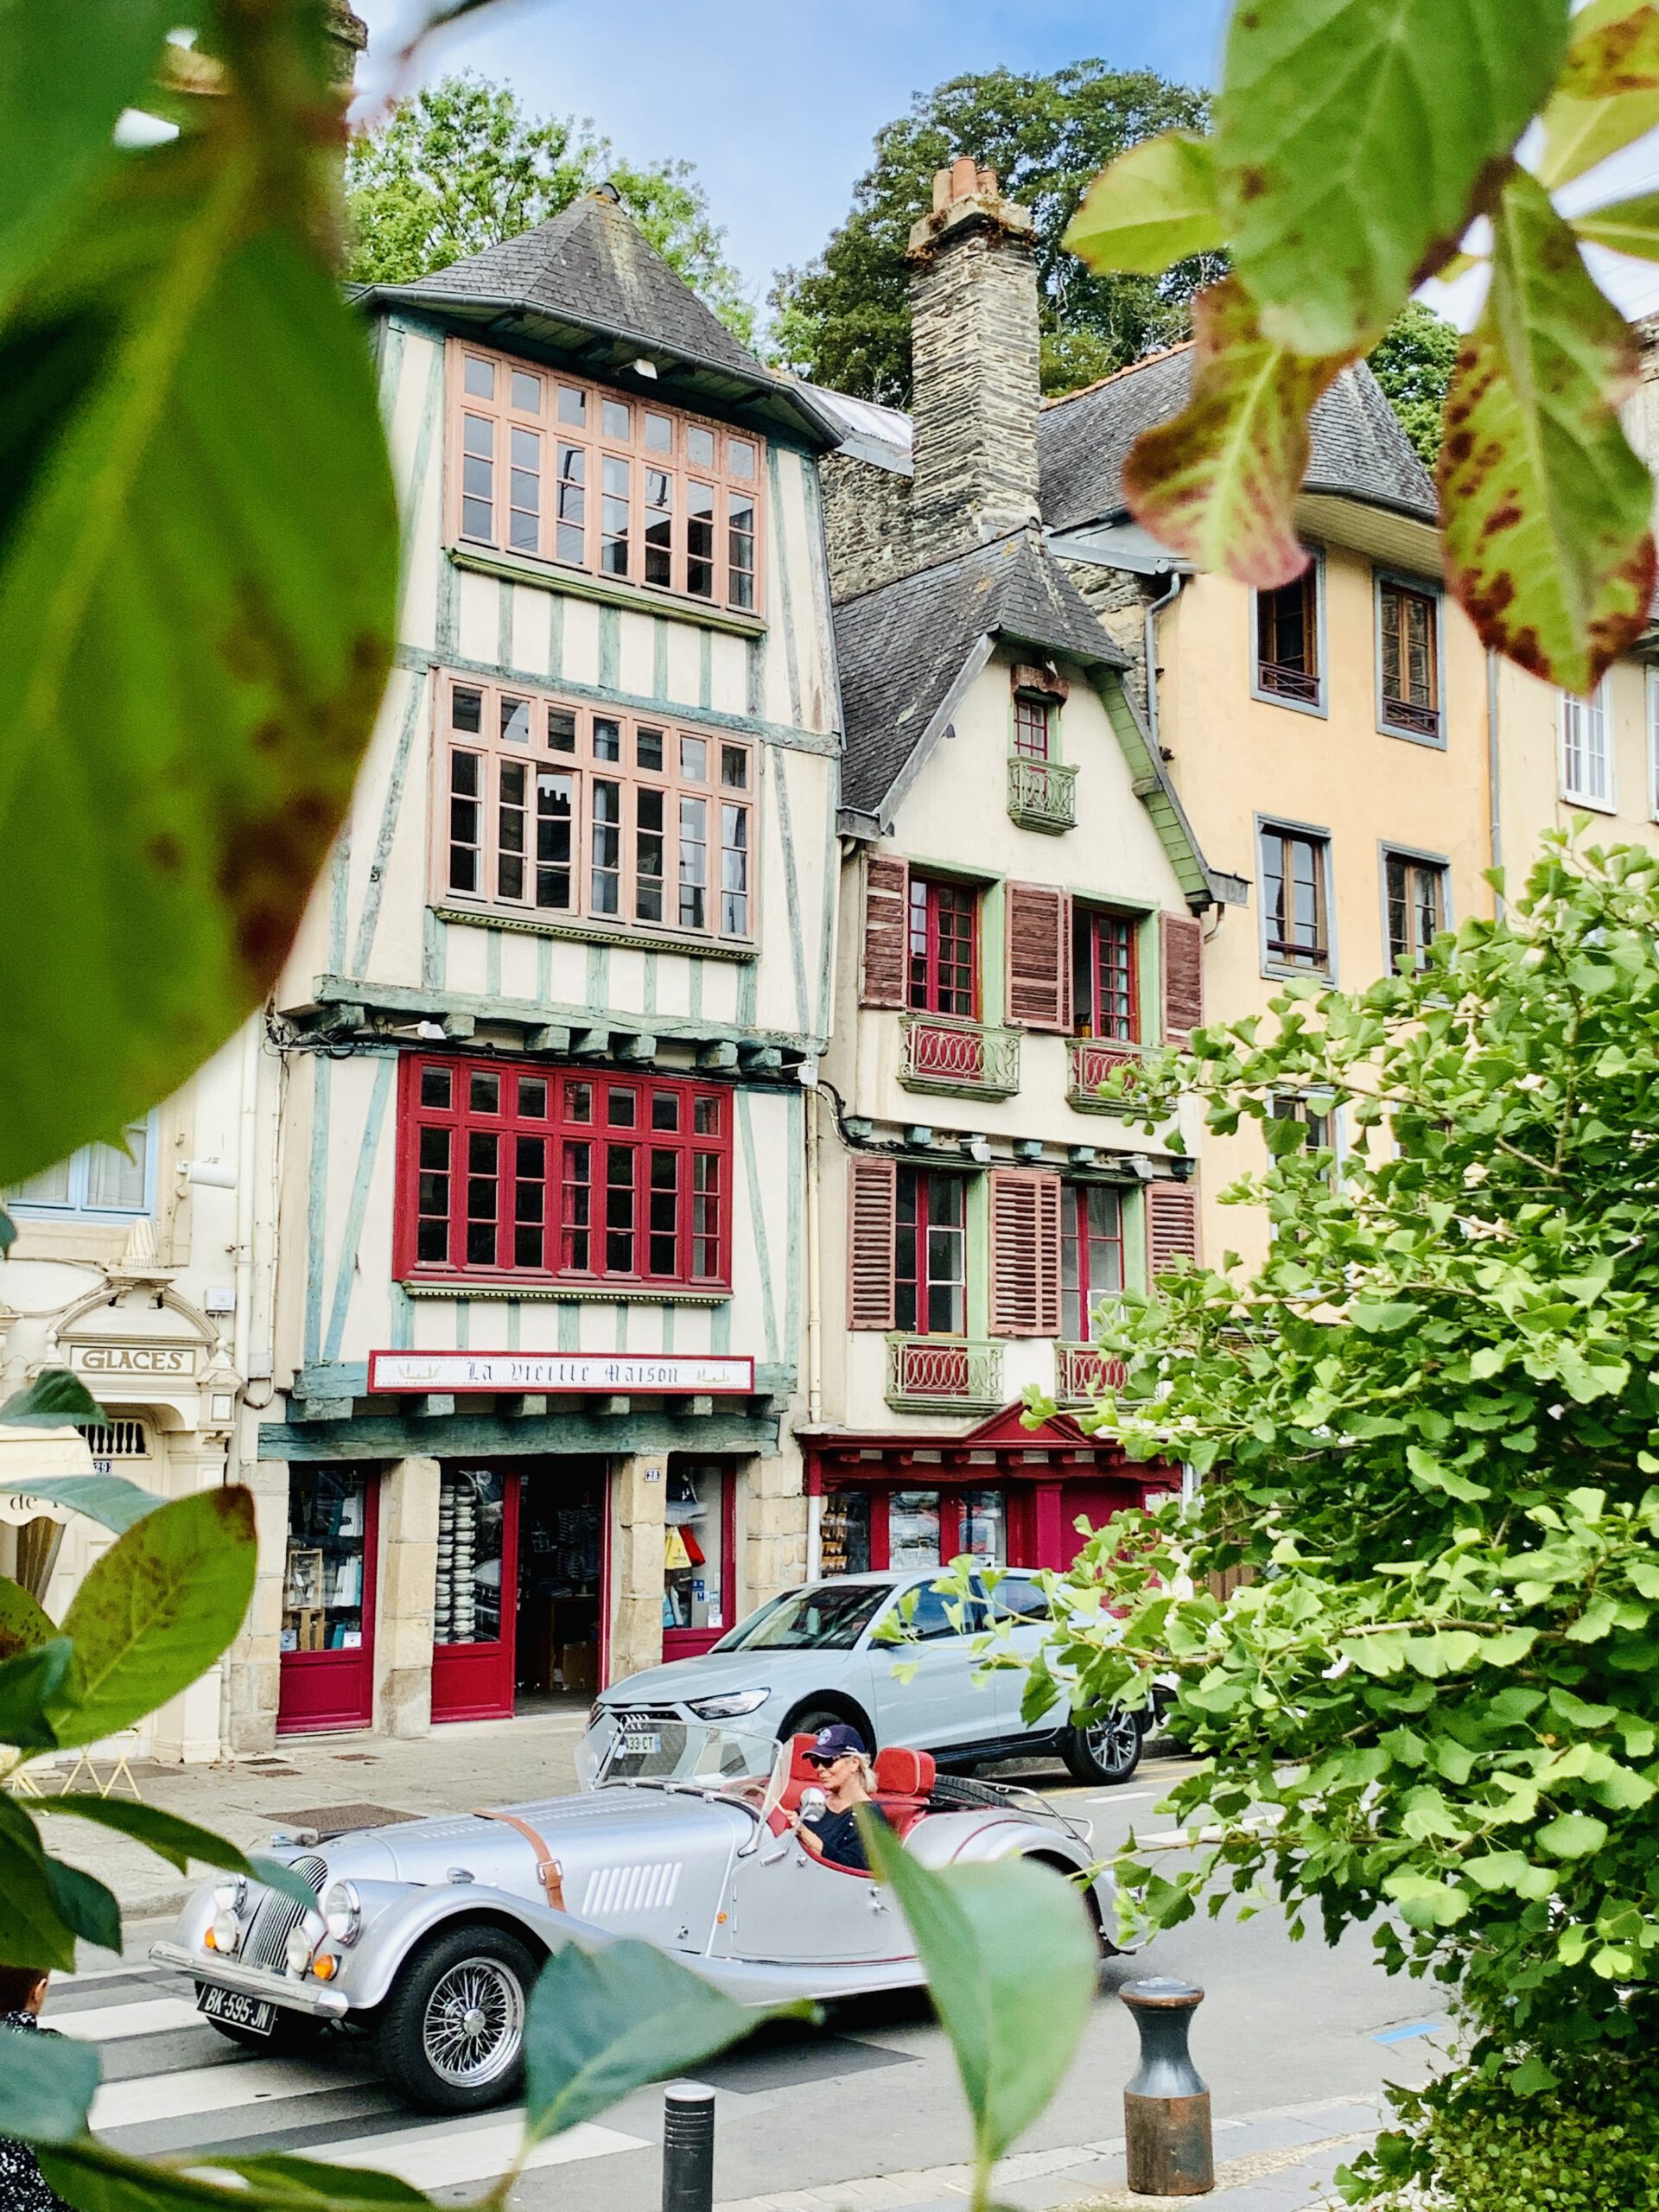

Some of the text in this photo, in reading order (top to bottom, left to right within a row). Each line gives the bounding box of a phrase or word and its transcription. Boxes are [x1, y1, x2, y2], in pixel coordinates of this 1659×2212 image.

[82, 1350, 183, 1370] GLACES
[467, 1362, 677, 1382] La Vieille Maison
[95, 1462, 109, 1472] 29
[10, 1494, 39, 1510] de
[205, 1988, 270, 2028] BK-595-JN
